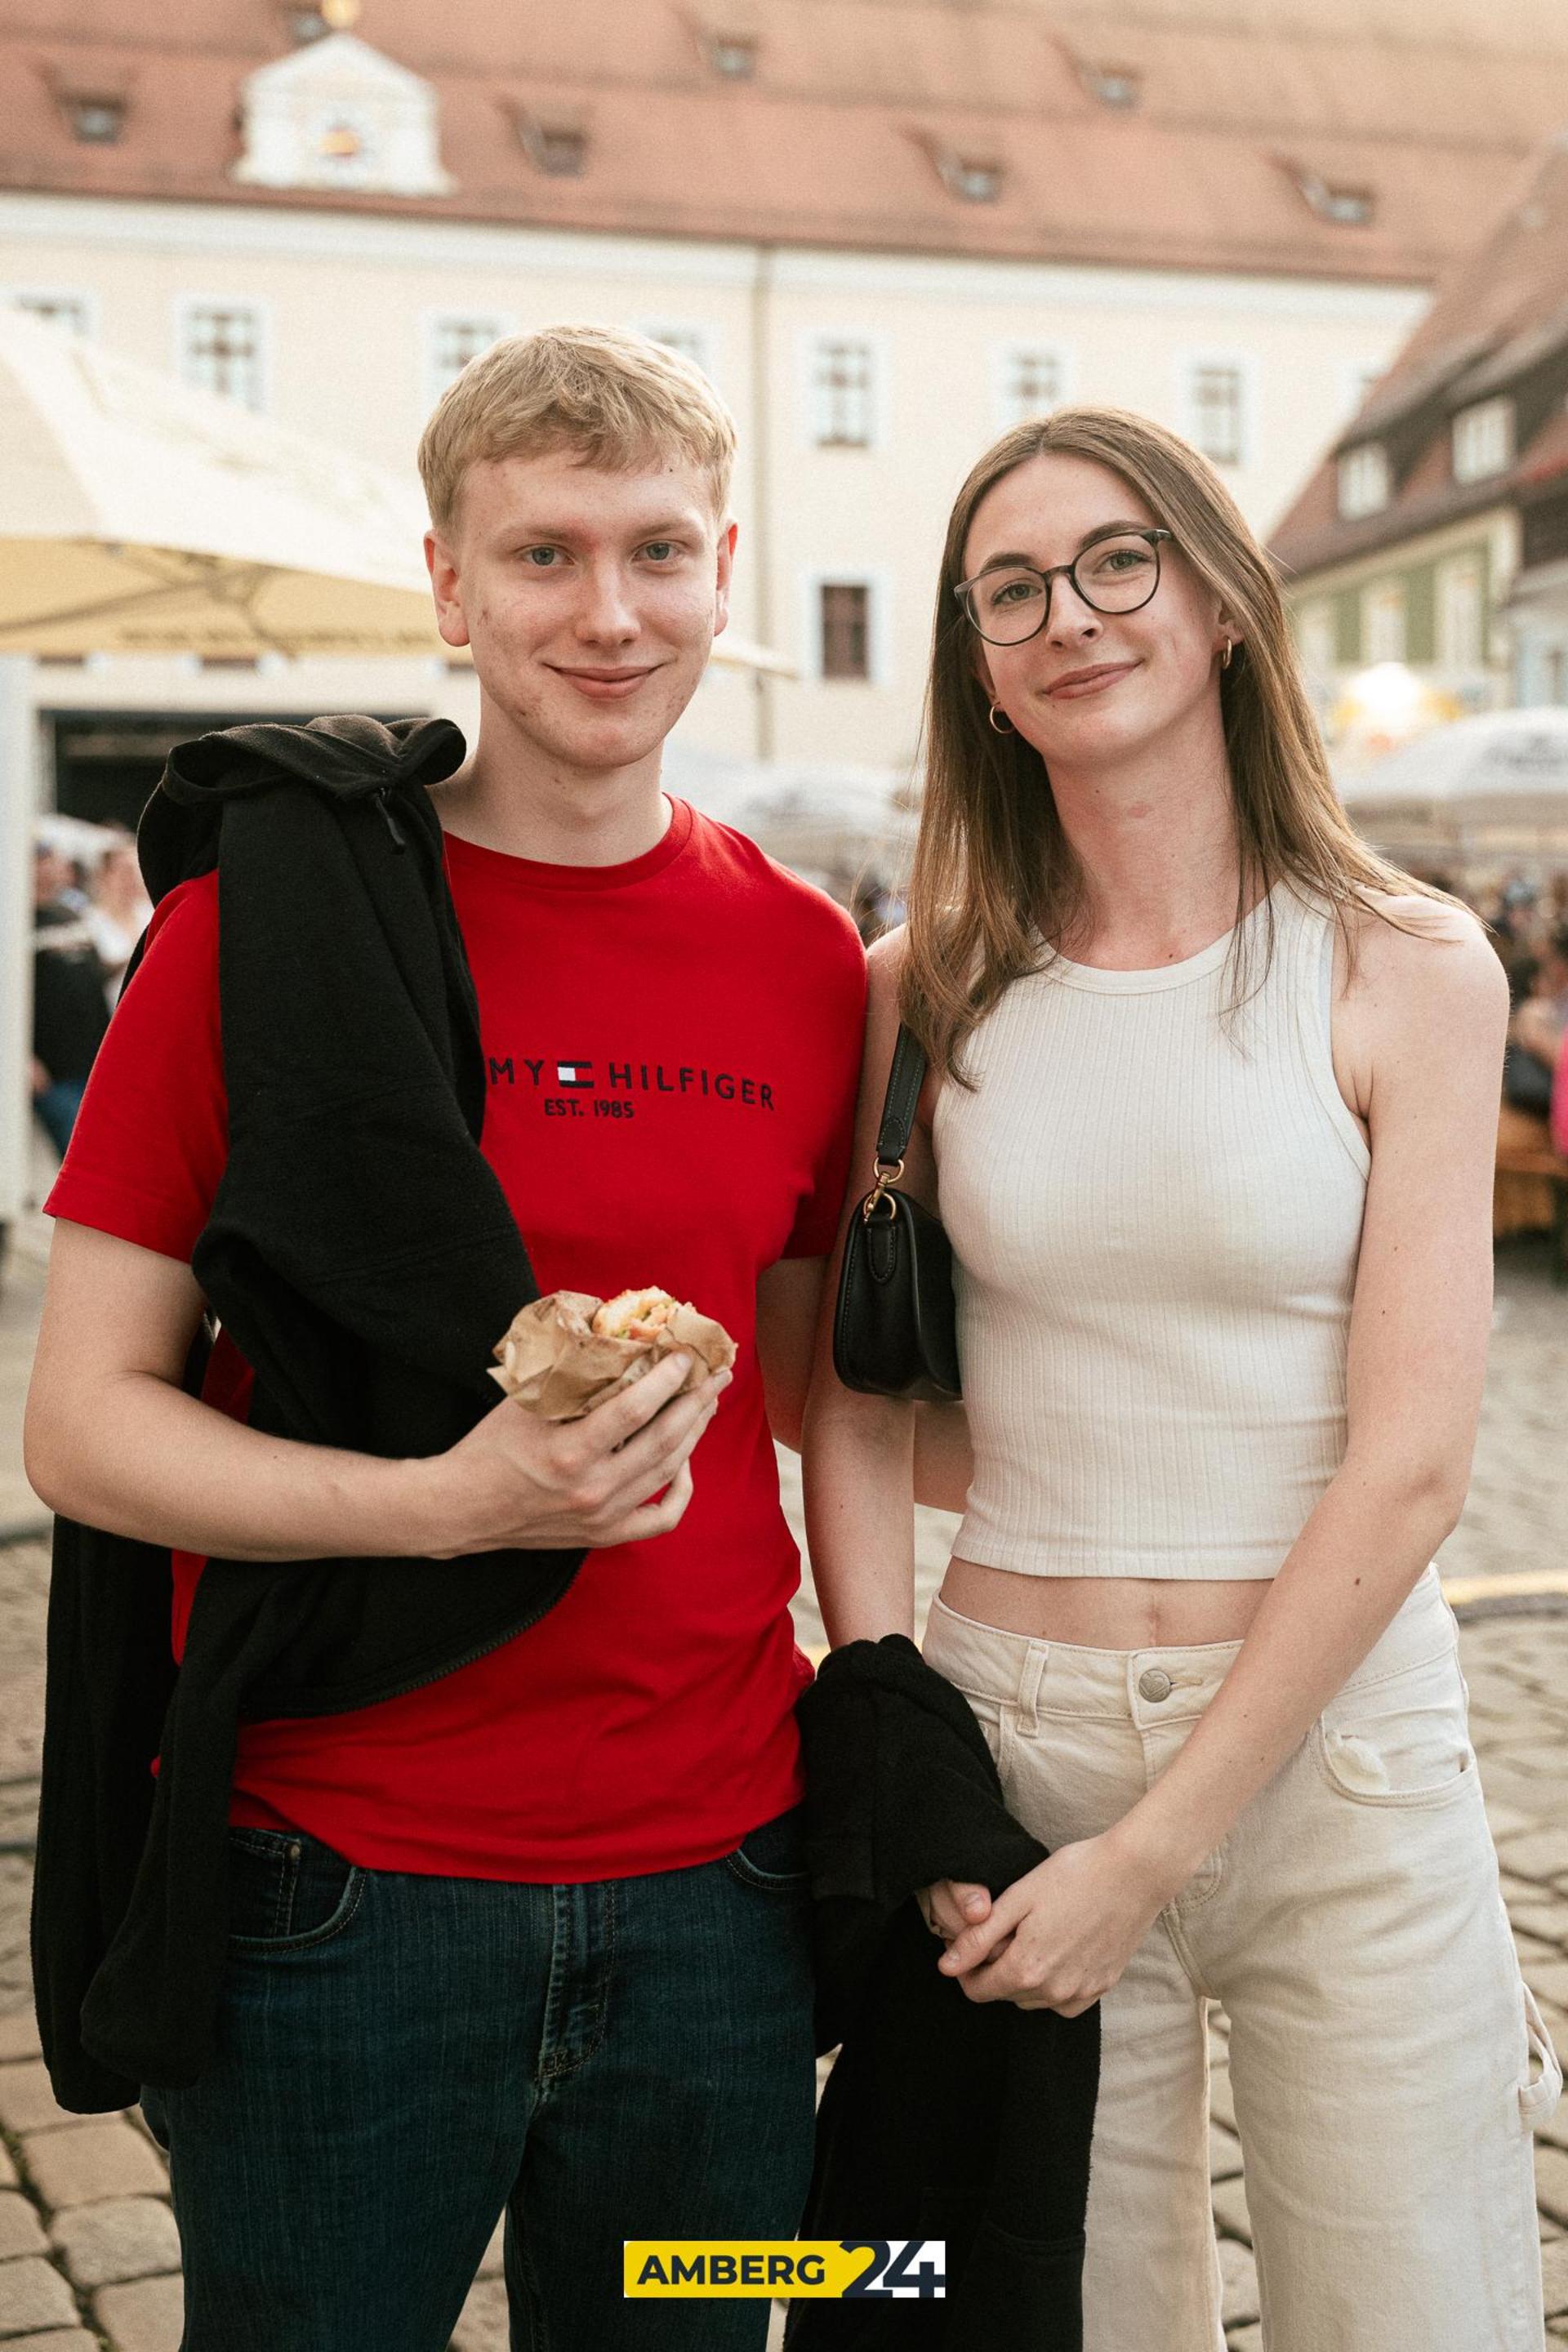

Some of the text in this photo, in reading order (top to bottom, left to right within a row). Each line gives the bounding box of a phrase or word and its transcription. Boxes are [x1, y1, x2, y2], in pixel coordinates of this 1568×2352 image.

[608, 1061, 775, 1111] HILFIGER
[544, 1098, 635, 1119] EST. 1985
